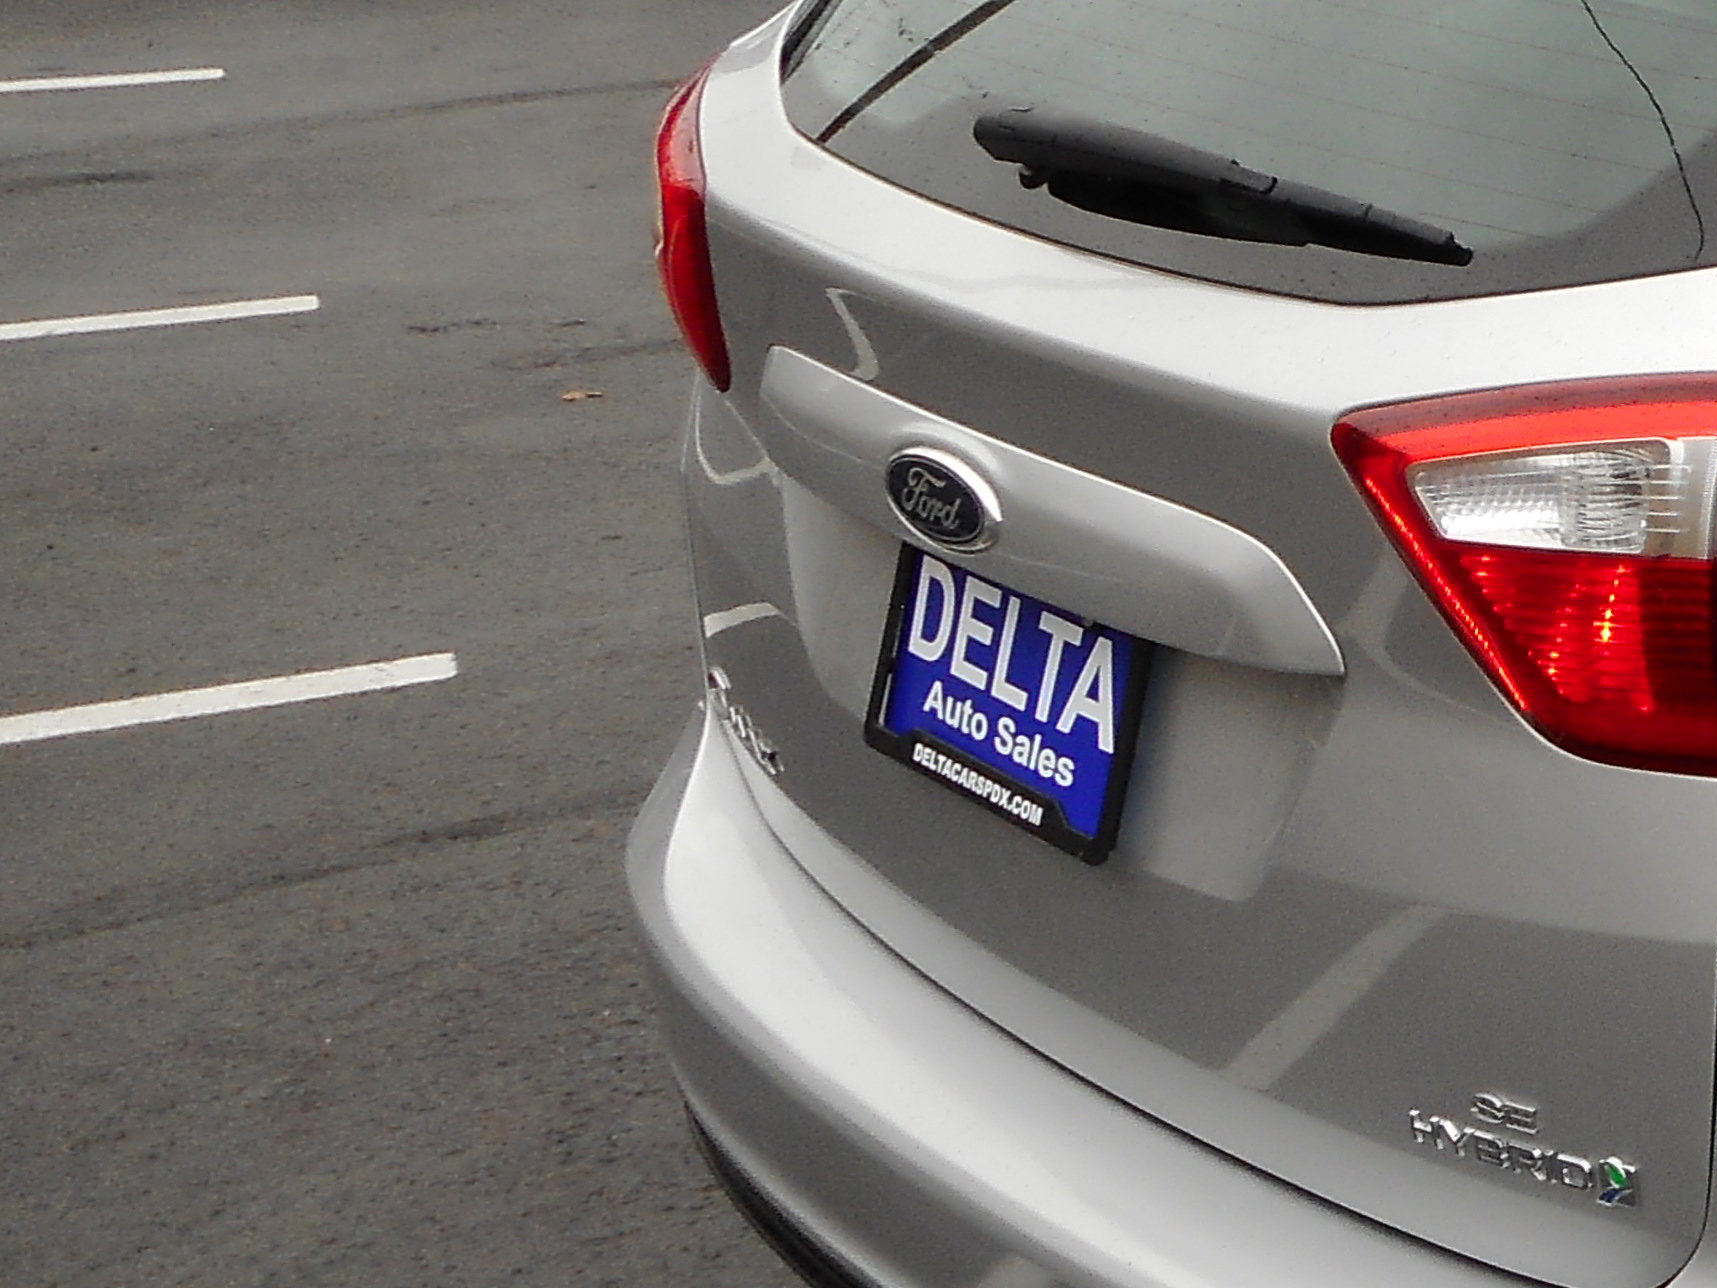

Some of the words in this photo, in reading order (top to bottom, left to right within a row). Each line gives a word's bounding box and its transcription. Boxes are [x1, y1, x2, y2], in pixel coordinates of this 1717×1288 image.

[902, 466, 961, 530] Ford
[907, 554, 1116, 755] DELTA
[923, 680, 988, 741] Auto
[994, 717, 1076, 788] Sales
[912, 741, 1044, 827] DELTACARSPDX.COM
[1408, 1108, 1594, 1192] HYBRID
[1470, 1093, 1540, 1135] SE
